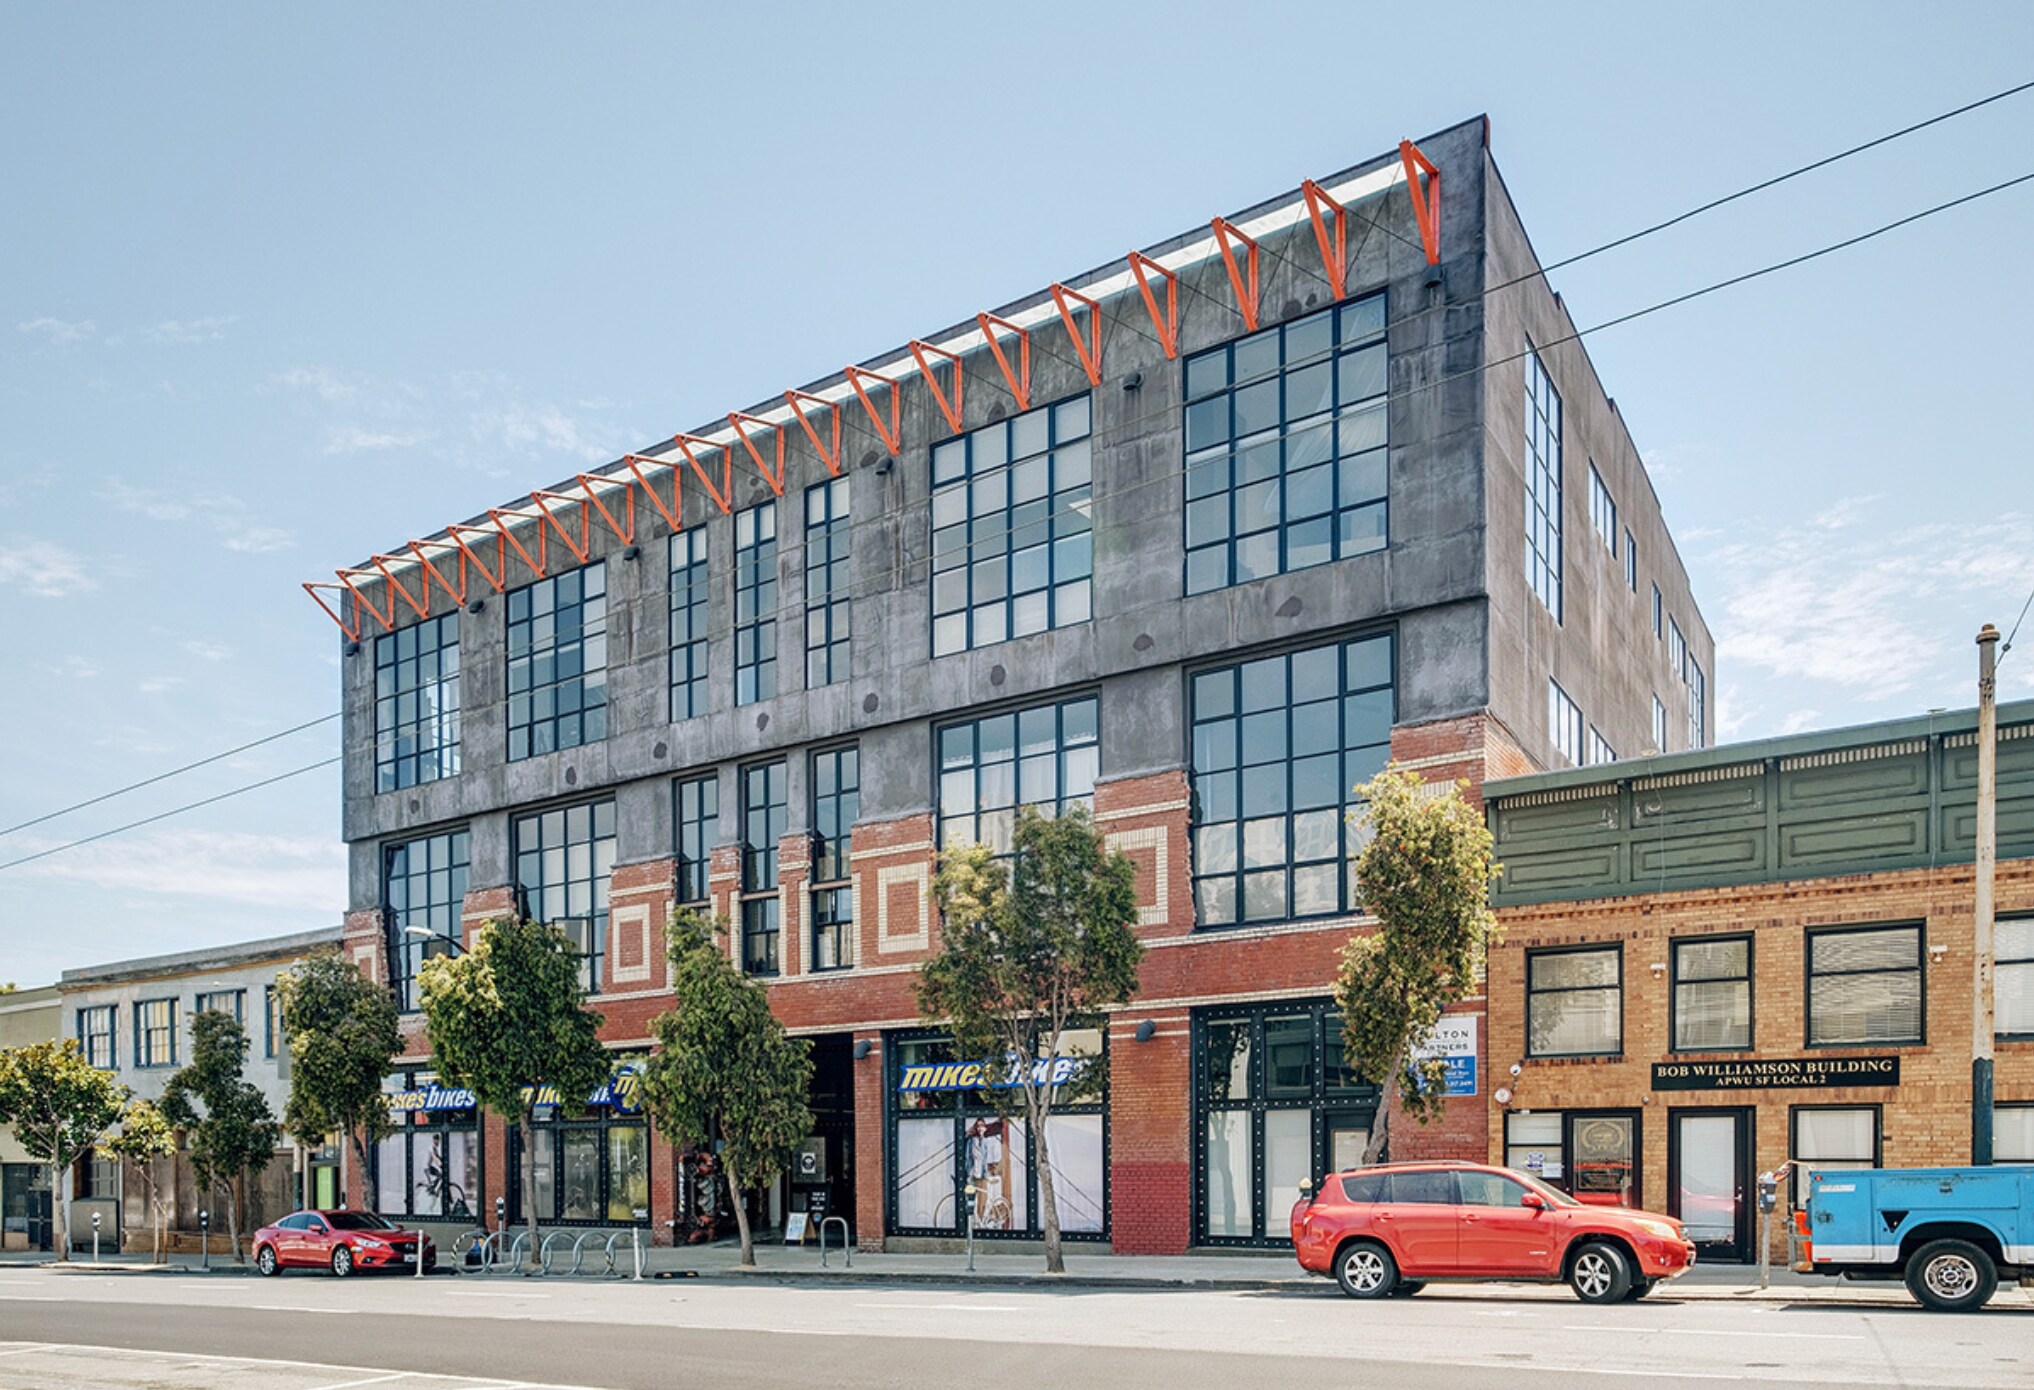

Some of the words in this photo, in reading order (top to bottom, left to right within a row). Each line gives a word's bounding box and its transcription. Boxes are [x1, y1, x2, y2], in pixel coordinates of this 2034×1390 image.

[1436, 1031, 1469, 1039] LTON
[1657, 1066, 1689, 1077] BOB
[1693, 1063, 1801, 1076] WILLIAMSON
[1807, 1060, 1893, 1073] BUILDING
[1716, 1076, 1751, 1086] APWU
[1755, 1076, 1770, 1085] SF
[1773, 1075, 1817, 1085] LOCAL
[1819, 1075, 1827, 1083] 2
[427, 1085, 476, 1108] bikes
